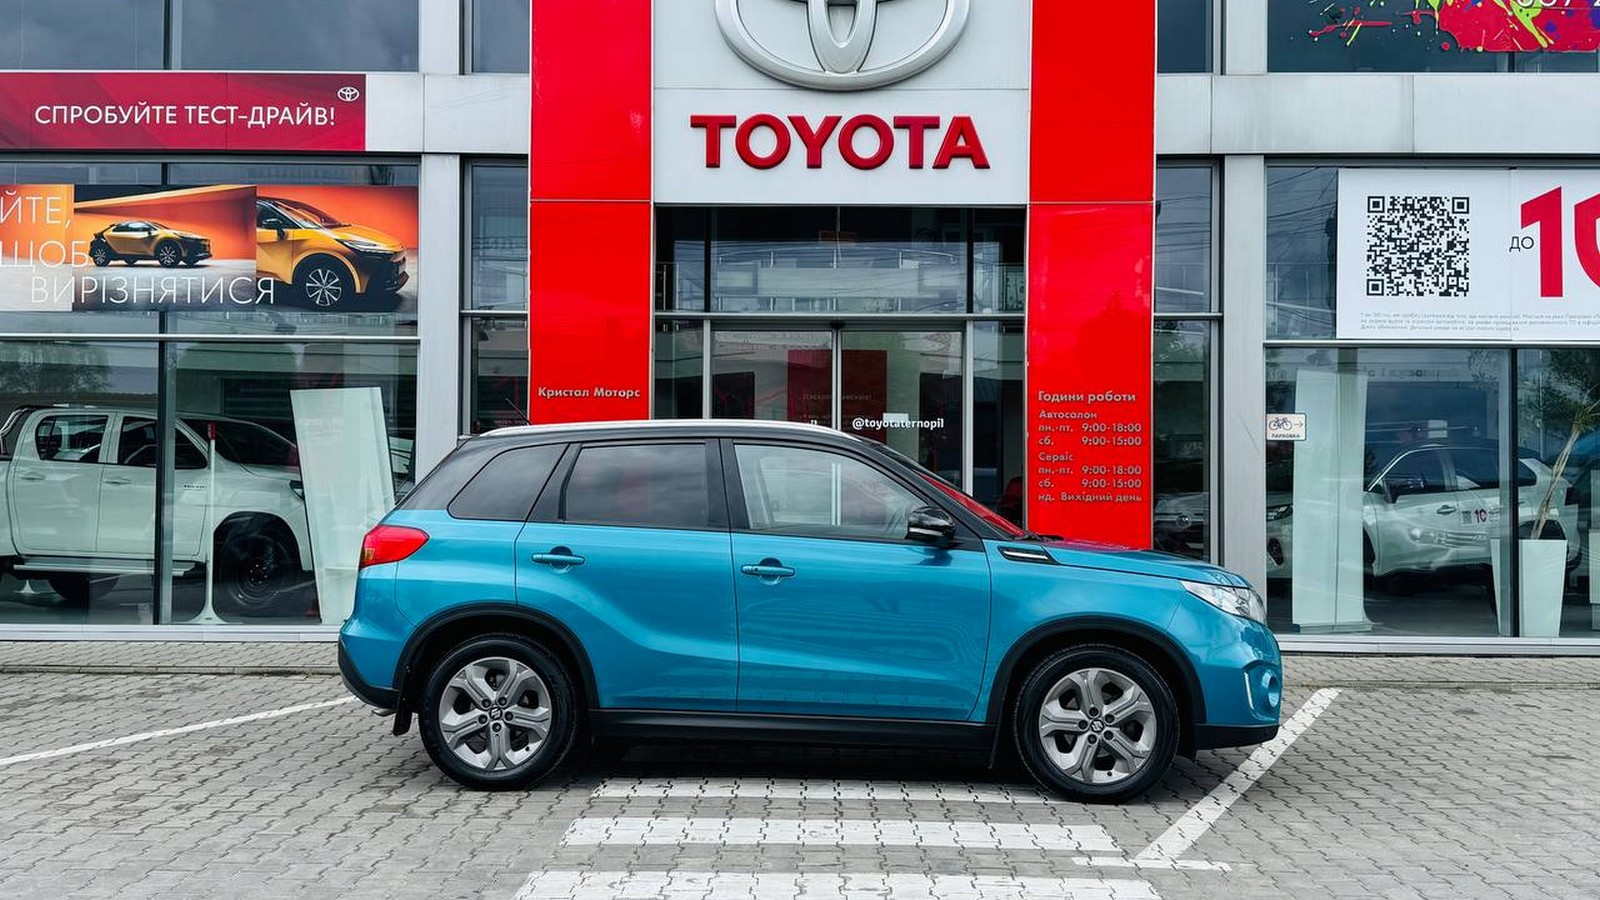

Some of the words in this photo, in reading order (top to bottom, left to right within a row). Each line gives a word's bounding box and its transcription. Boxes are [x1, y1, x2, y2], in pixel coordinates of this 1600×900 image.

[35, 101, 178, 126] СПРОБУЙТЕ
[184, 102, 336, 129] ТЕСТ-ДРАЙВ!
[690, 113, 991, 170] TOYOTA
[31, 276, 275, 305] ВИРІЗНЯТИСЯ
[538, 386, 590, 399] Кристал
[593, 386, 641, 399] Моторс
[1038, 391, 1084, 402] Години
[1088, 390, 1136, 404] роботи
[1039, 410, 1098, 419] Автосалон
[852, 417, 944, 431] @toyotaternopil
[1082, 423, 1142, 432] 9:00-18:00
[1038, 436, 1055, 446] сб.
[1082, 436, 1142, 446] 9:00-15:00
[1038, 452, 1075, 463] Сервіс
[1082, 465, 1142, 475] 9:00-18:00
[1038, 478, 1055, 488] сб.
[1082, 478, 1142, 488] 9:00-15:00
[1038, 494, 1056, 502] нд.
[1061, 491, 1113, 502] Вихідний
[1115, 494, 1142, 502] день
